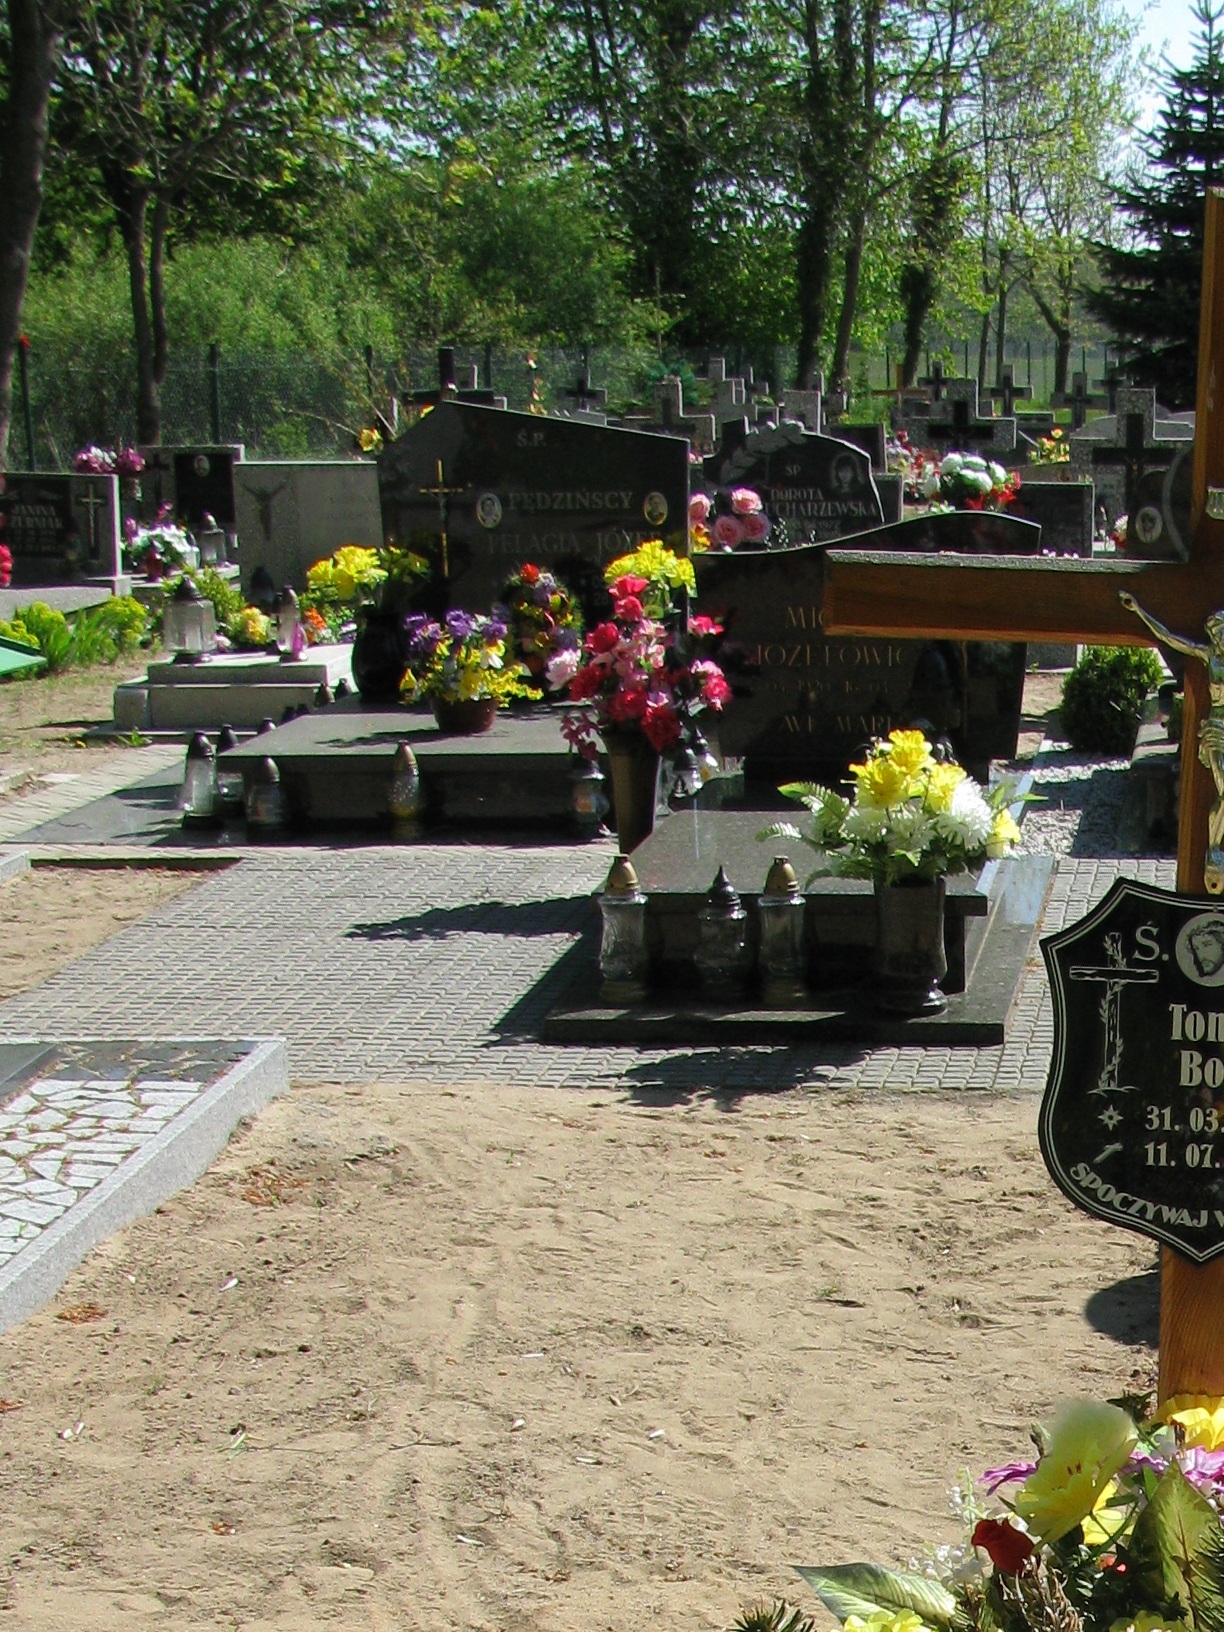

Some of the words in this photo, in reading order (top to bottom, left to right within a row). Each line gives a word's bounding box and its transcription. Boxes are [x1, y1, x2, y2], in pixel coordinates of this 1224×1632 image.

[508, 487, 633, 513] PĘDZIŃSCY
[771, 488, 824, 501] DOROTA
[764, 501, 877, 518] UCHARZEWSKA
[487, 531, 581, 554] PELAGIA
[1145, 1105, 1180, 1132] 31.
[1144, 1141, 1176, 1167] 11.
[1185, 1143, 1221, 1169] 07.
[1070, 1162, 1209, 1228] SPOCZYWAJ
